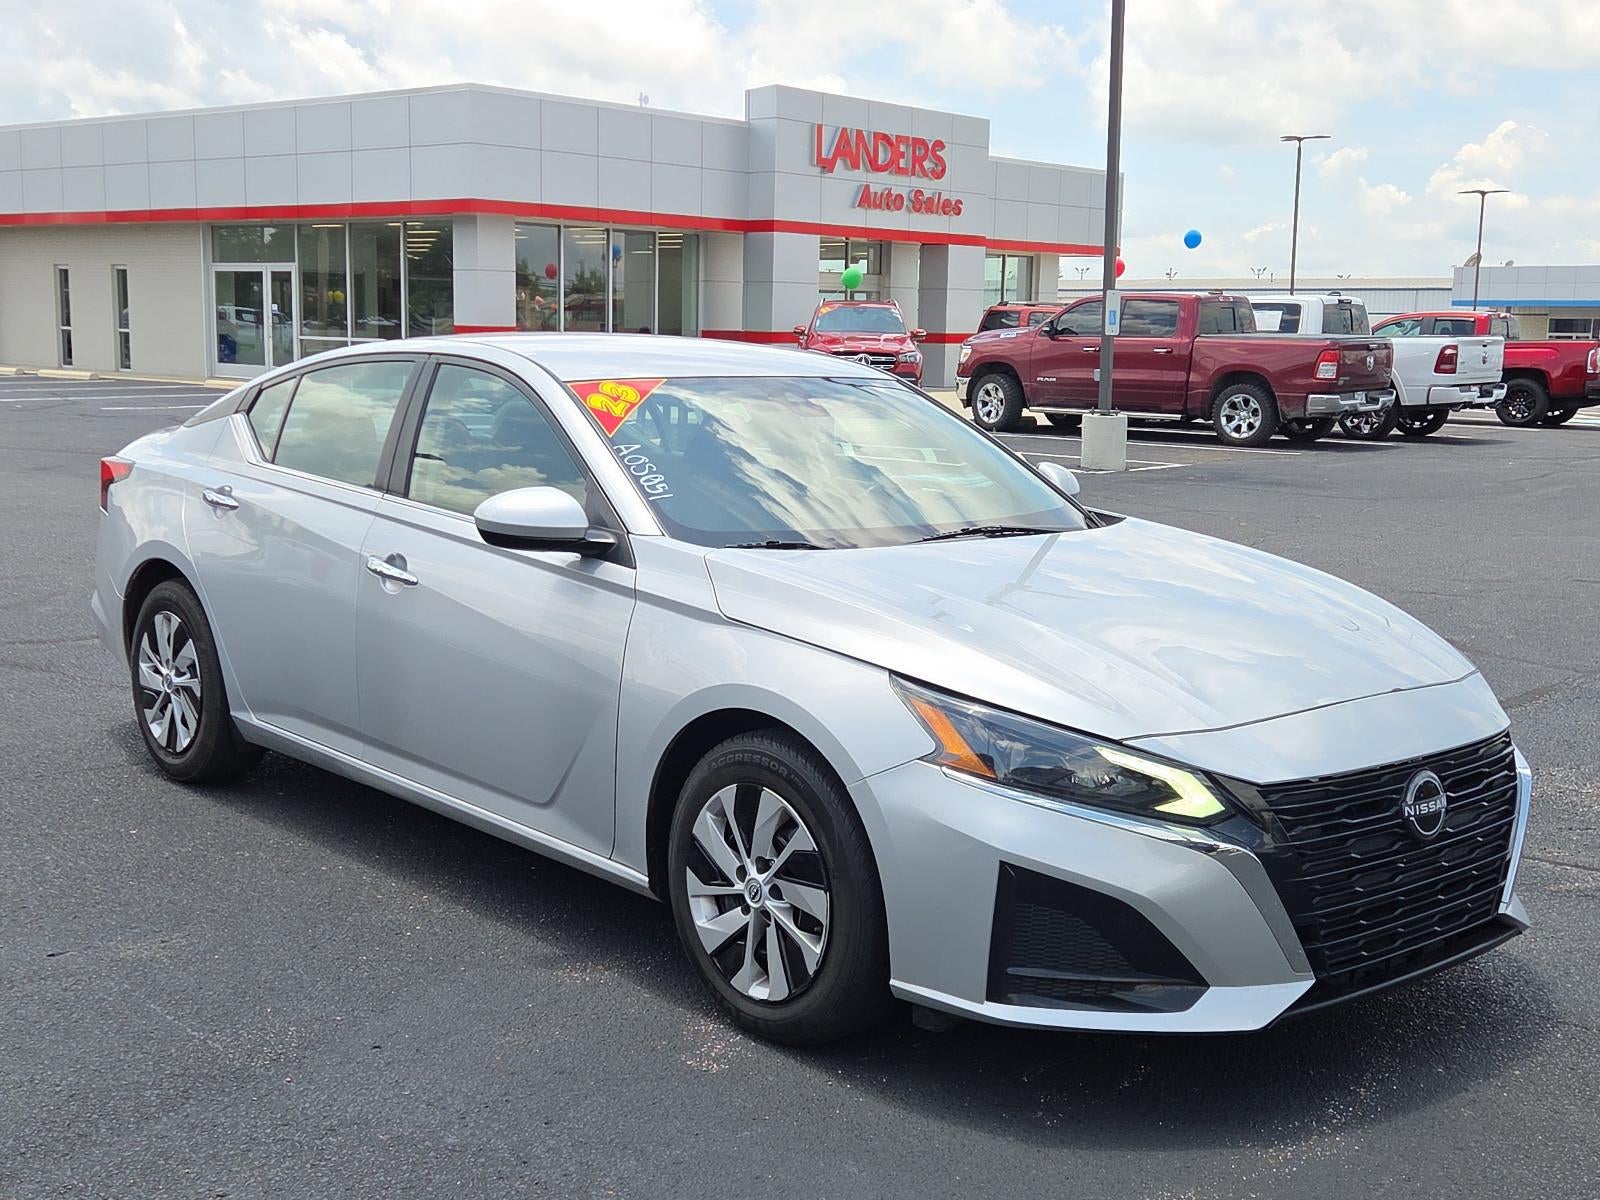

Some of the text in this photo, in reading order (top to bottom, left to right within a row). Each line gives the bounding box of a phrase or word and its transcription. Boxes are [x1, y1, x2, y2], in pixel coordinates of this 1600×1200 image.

[815, 123, 947, 180] LANDERS
[857, 183, 964, 217] Auto Sales
[587, 381, 640, 417] 23
[1404, 792, 1447, 816] NISSAN
